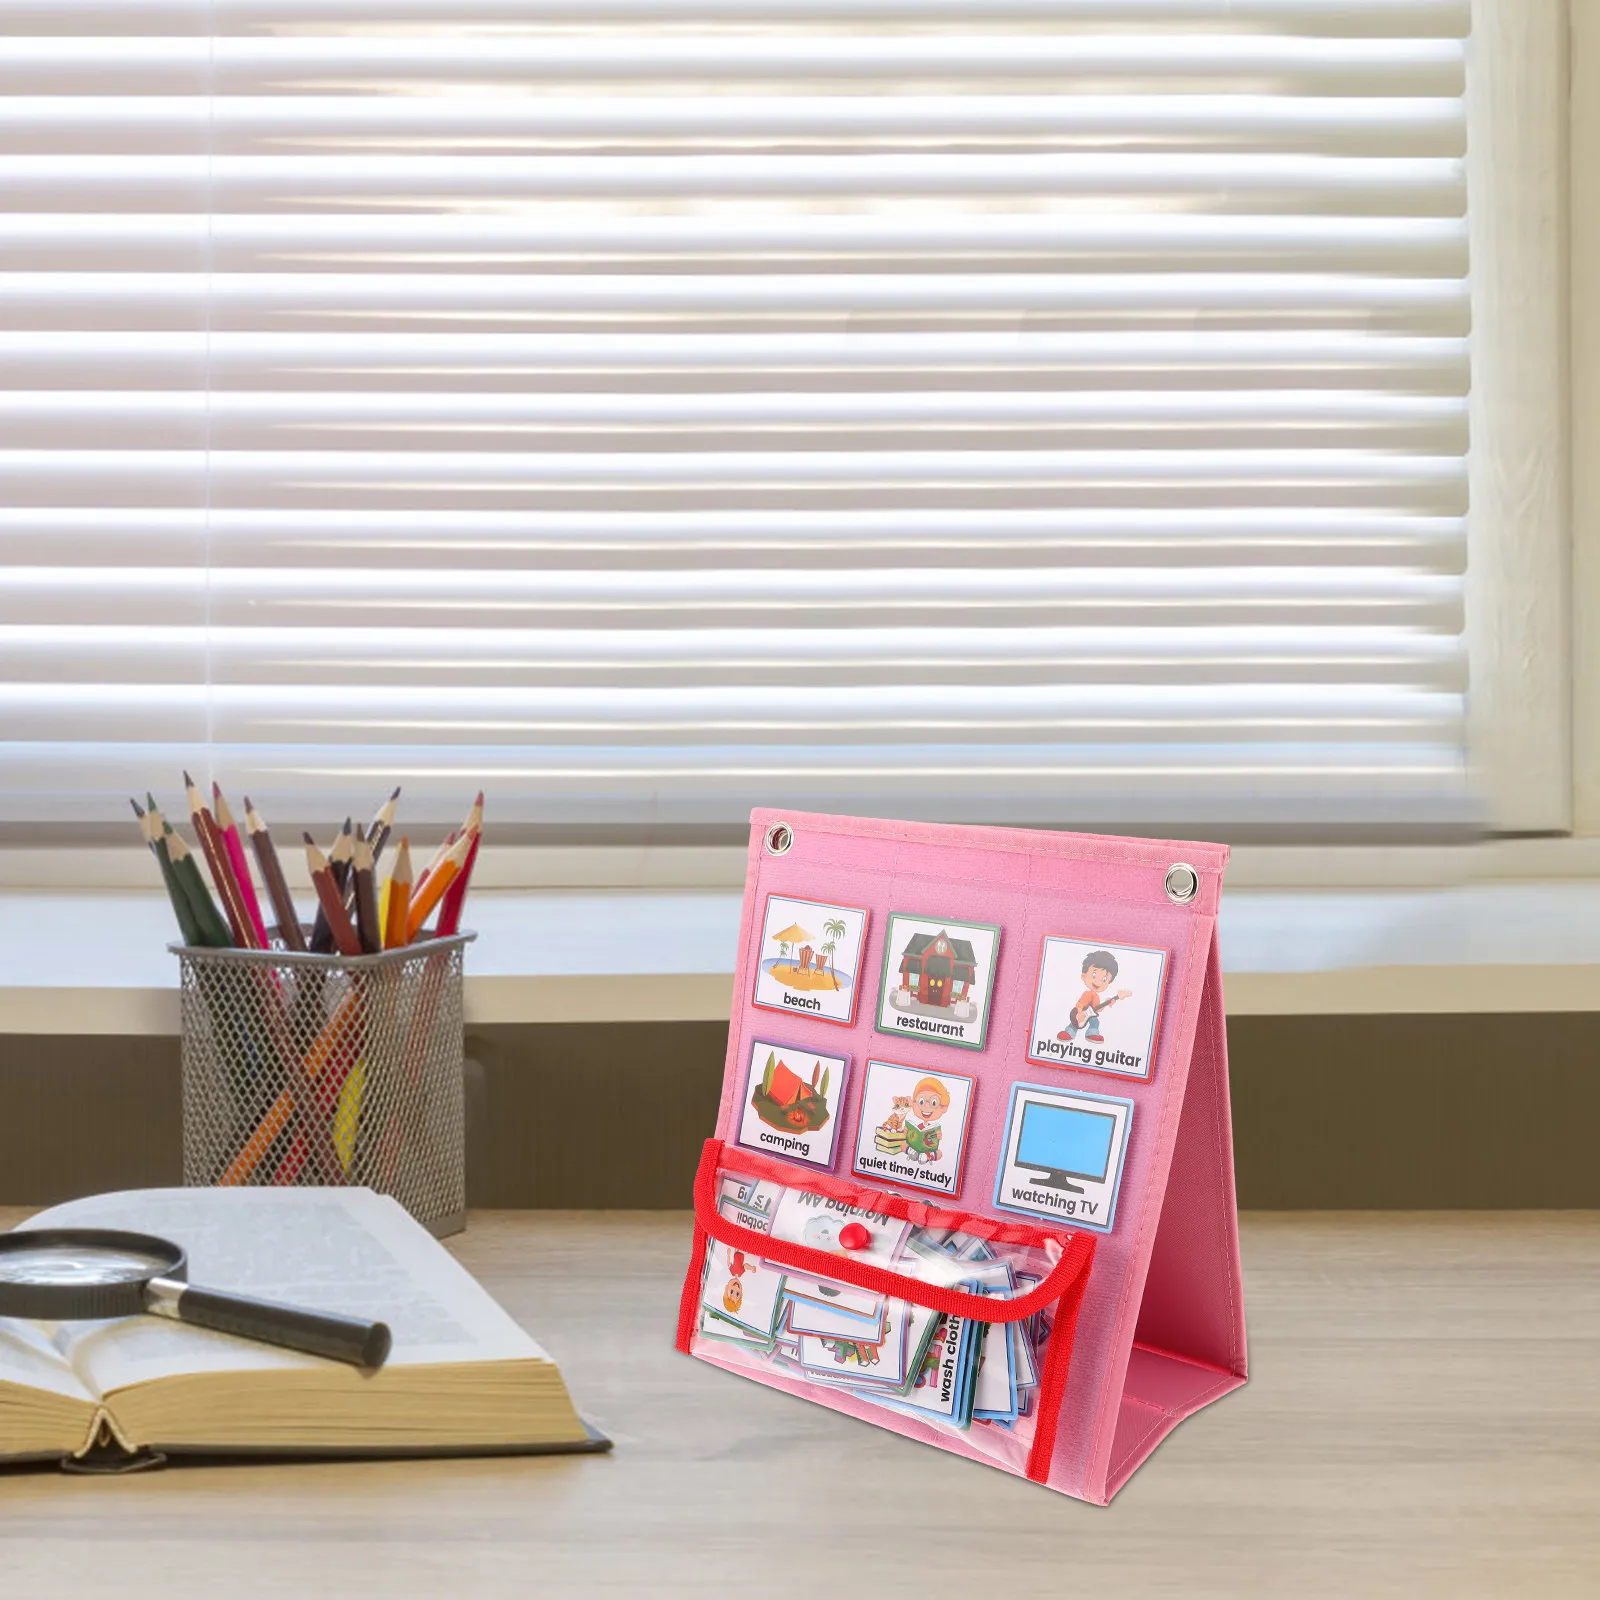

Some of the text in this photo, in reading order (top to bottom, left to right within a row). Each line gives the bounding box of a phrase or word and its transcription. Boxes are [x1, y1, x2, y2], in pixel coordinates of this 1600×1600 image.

[783, 992, 821, 1011] beach
[896, 1015, 965, 1037] restaurant
[1036, 1039, 1142, 1068] playing guitar
[760, 1132, 810, 1156] camping
[859, 1154, 952, 1187] quiet time/study
[797, 1190, 824, 1208] AM
[1012, 1187, 1099, 1215] watching TV
[736, 1211, 769, 1232] ootball
[941, 1360, 954, 1402] wash
